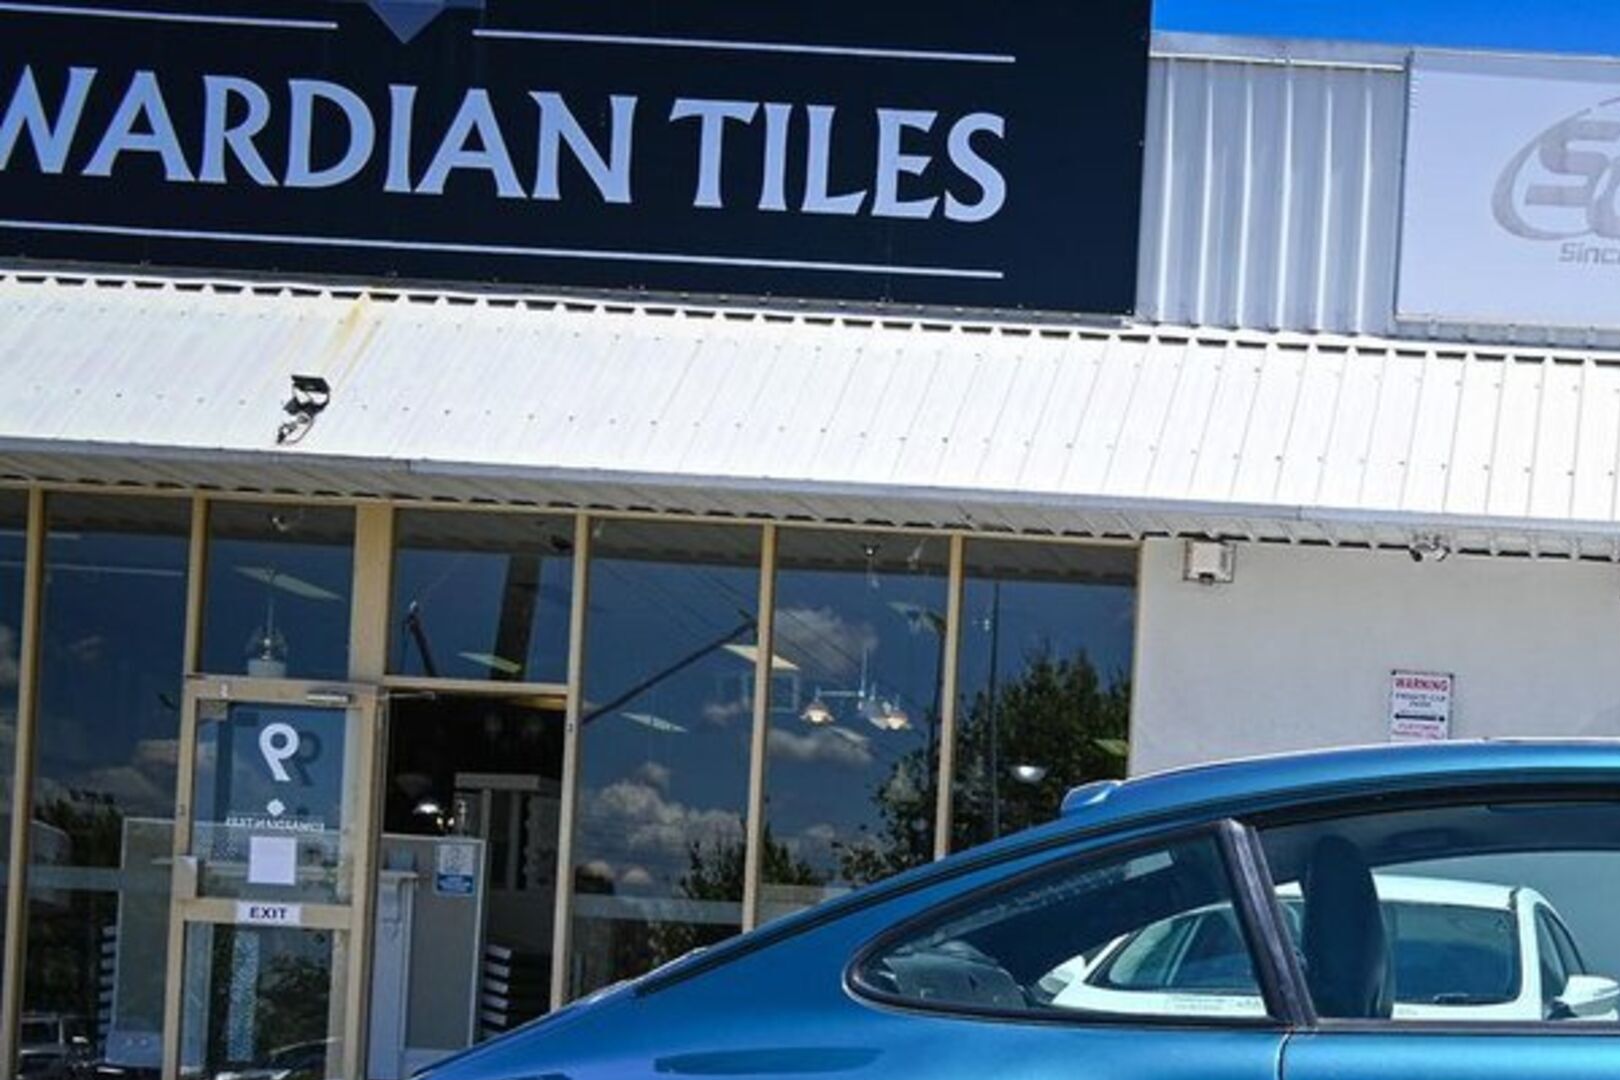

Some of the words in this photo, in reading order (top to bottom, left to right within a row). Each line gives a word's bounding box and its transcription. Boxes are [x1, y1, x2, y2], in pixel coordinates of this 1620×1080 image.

[0, 64, 637, 204] WARDIAN
[669, 97, 1005, 222] TILES
[249, 906, 288, 919] EXIT
